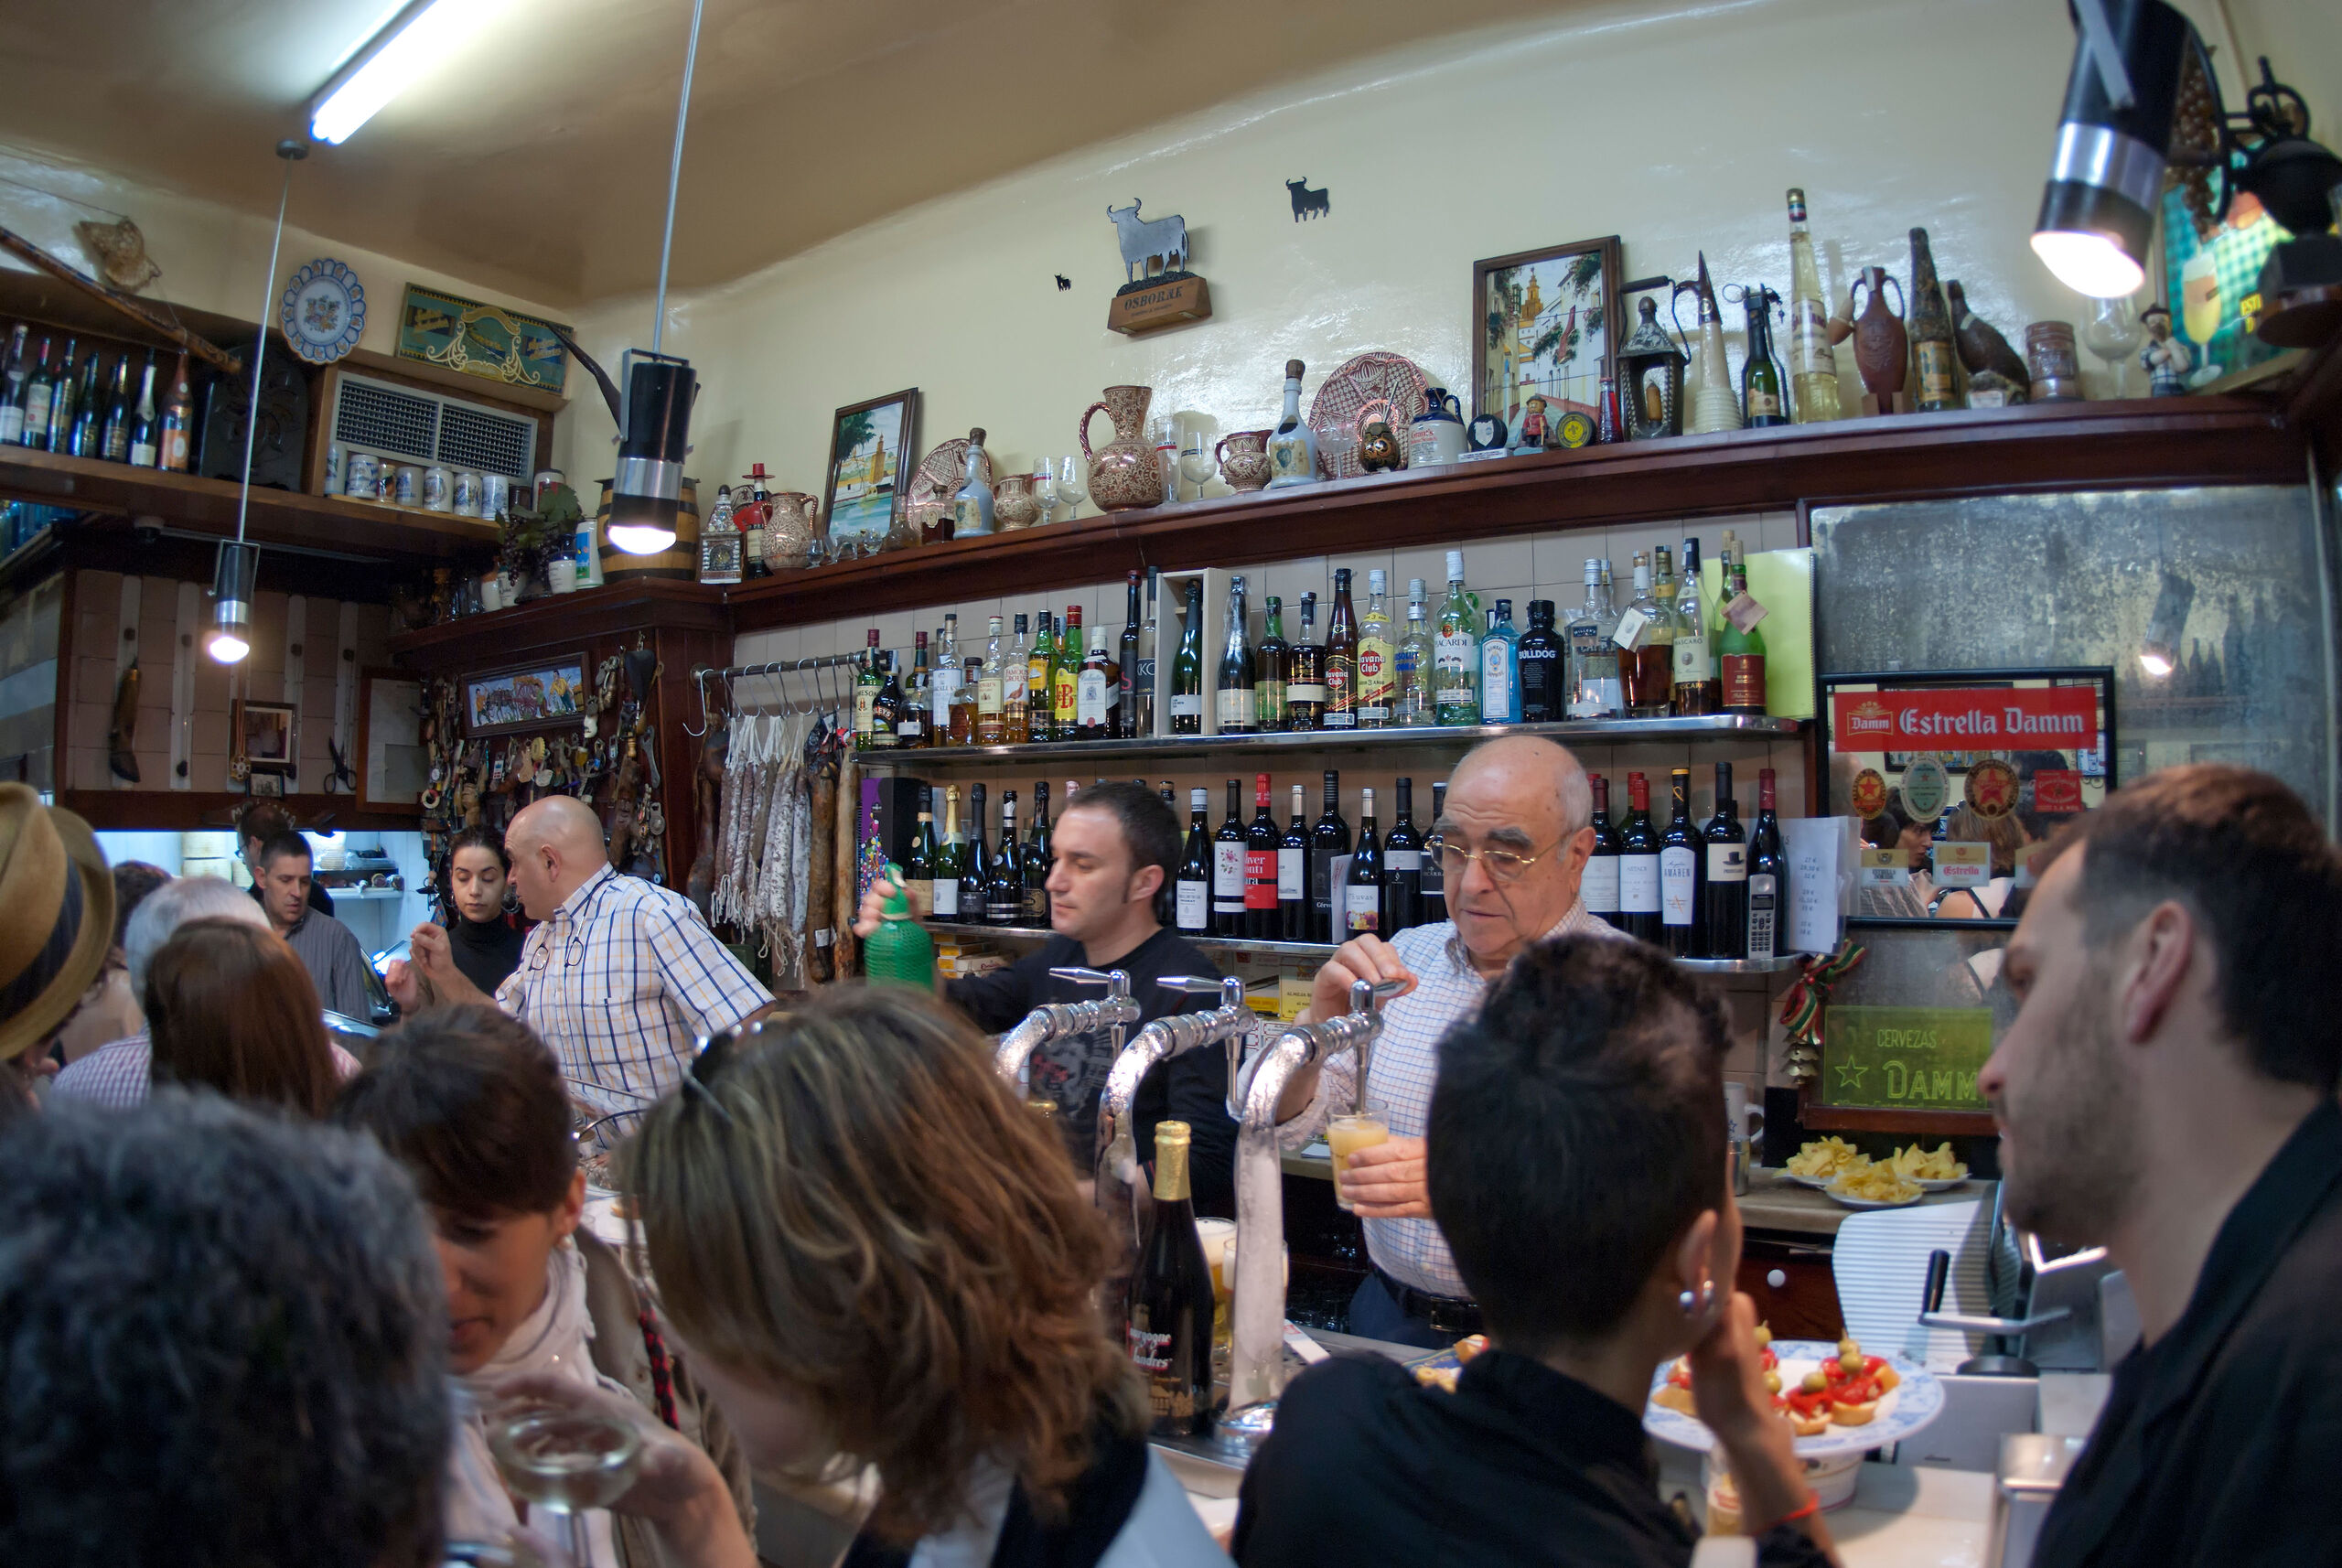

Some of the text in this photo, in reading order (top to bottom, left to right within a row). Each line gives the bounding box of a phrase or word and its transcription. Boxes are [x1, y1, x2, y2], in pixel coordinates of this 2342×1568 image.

[1124, 285, 1183, 311] OSBORNE
[1519, 650, 1556, 659] BULLDOG
[1360, 664, 1379, 672] Club
[1851, 716, 1890, 731] Damm
[1899, 706, 2084, 736] Estrella Damm
[1942, 865, 1980, 876] Estrella
[1877, 1028, 1937, 1048] CERVEZAS
[1882, 1059, 1987, 1101] DAMM
